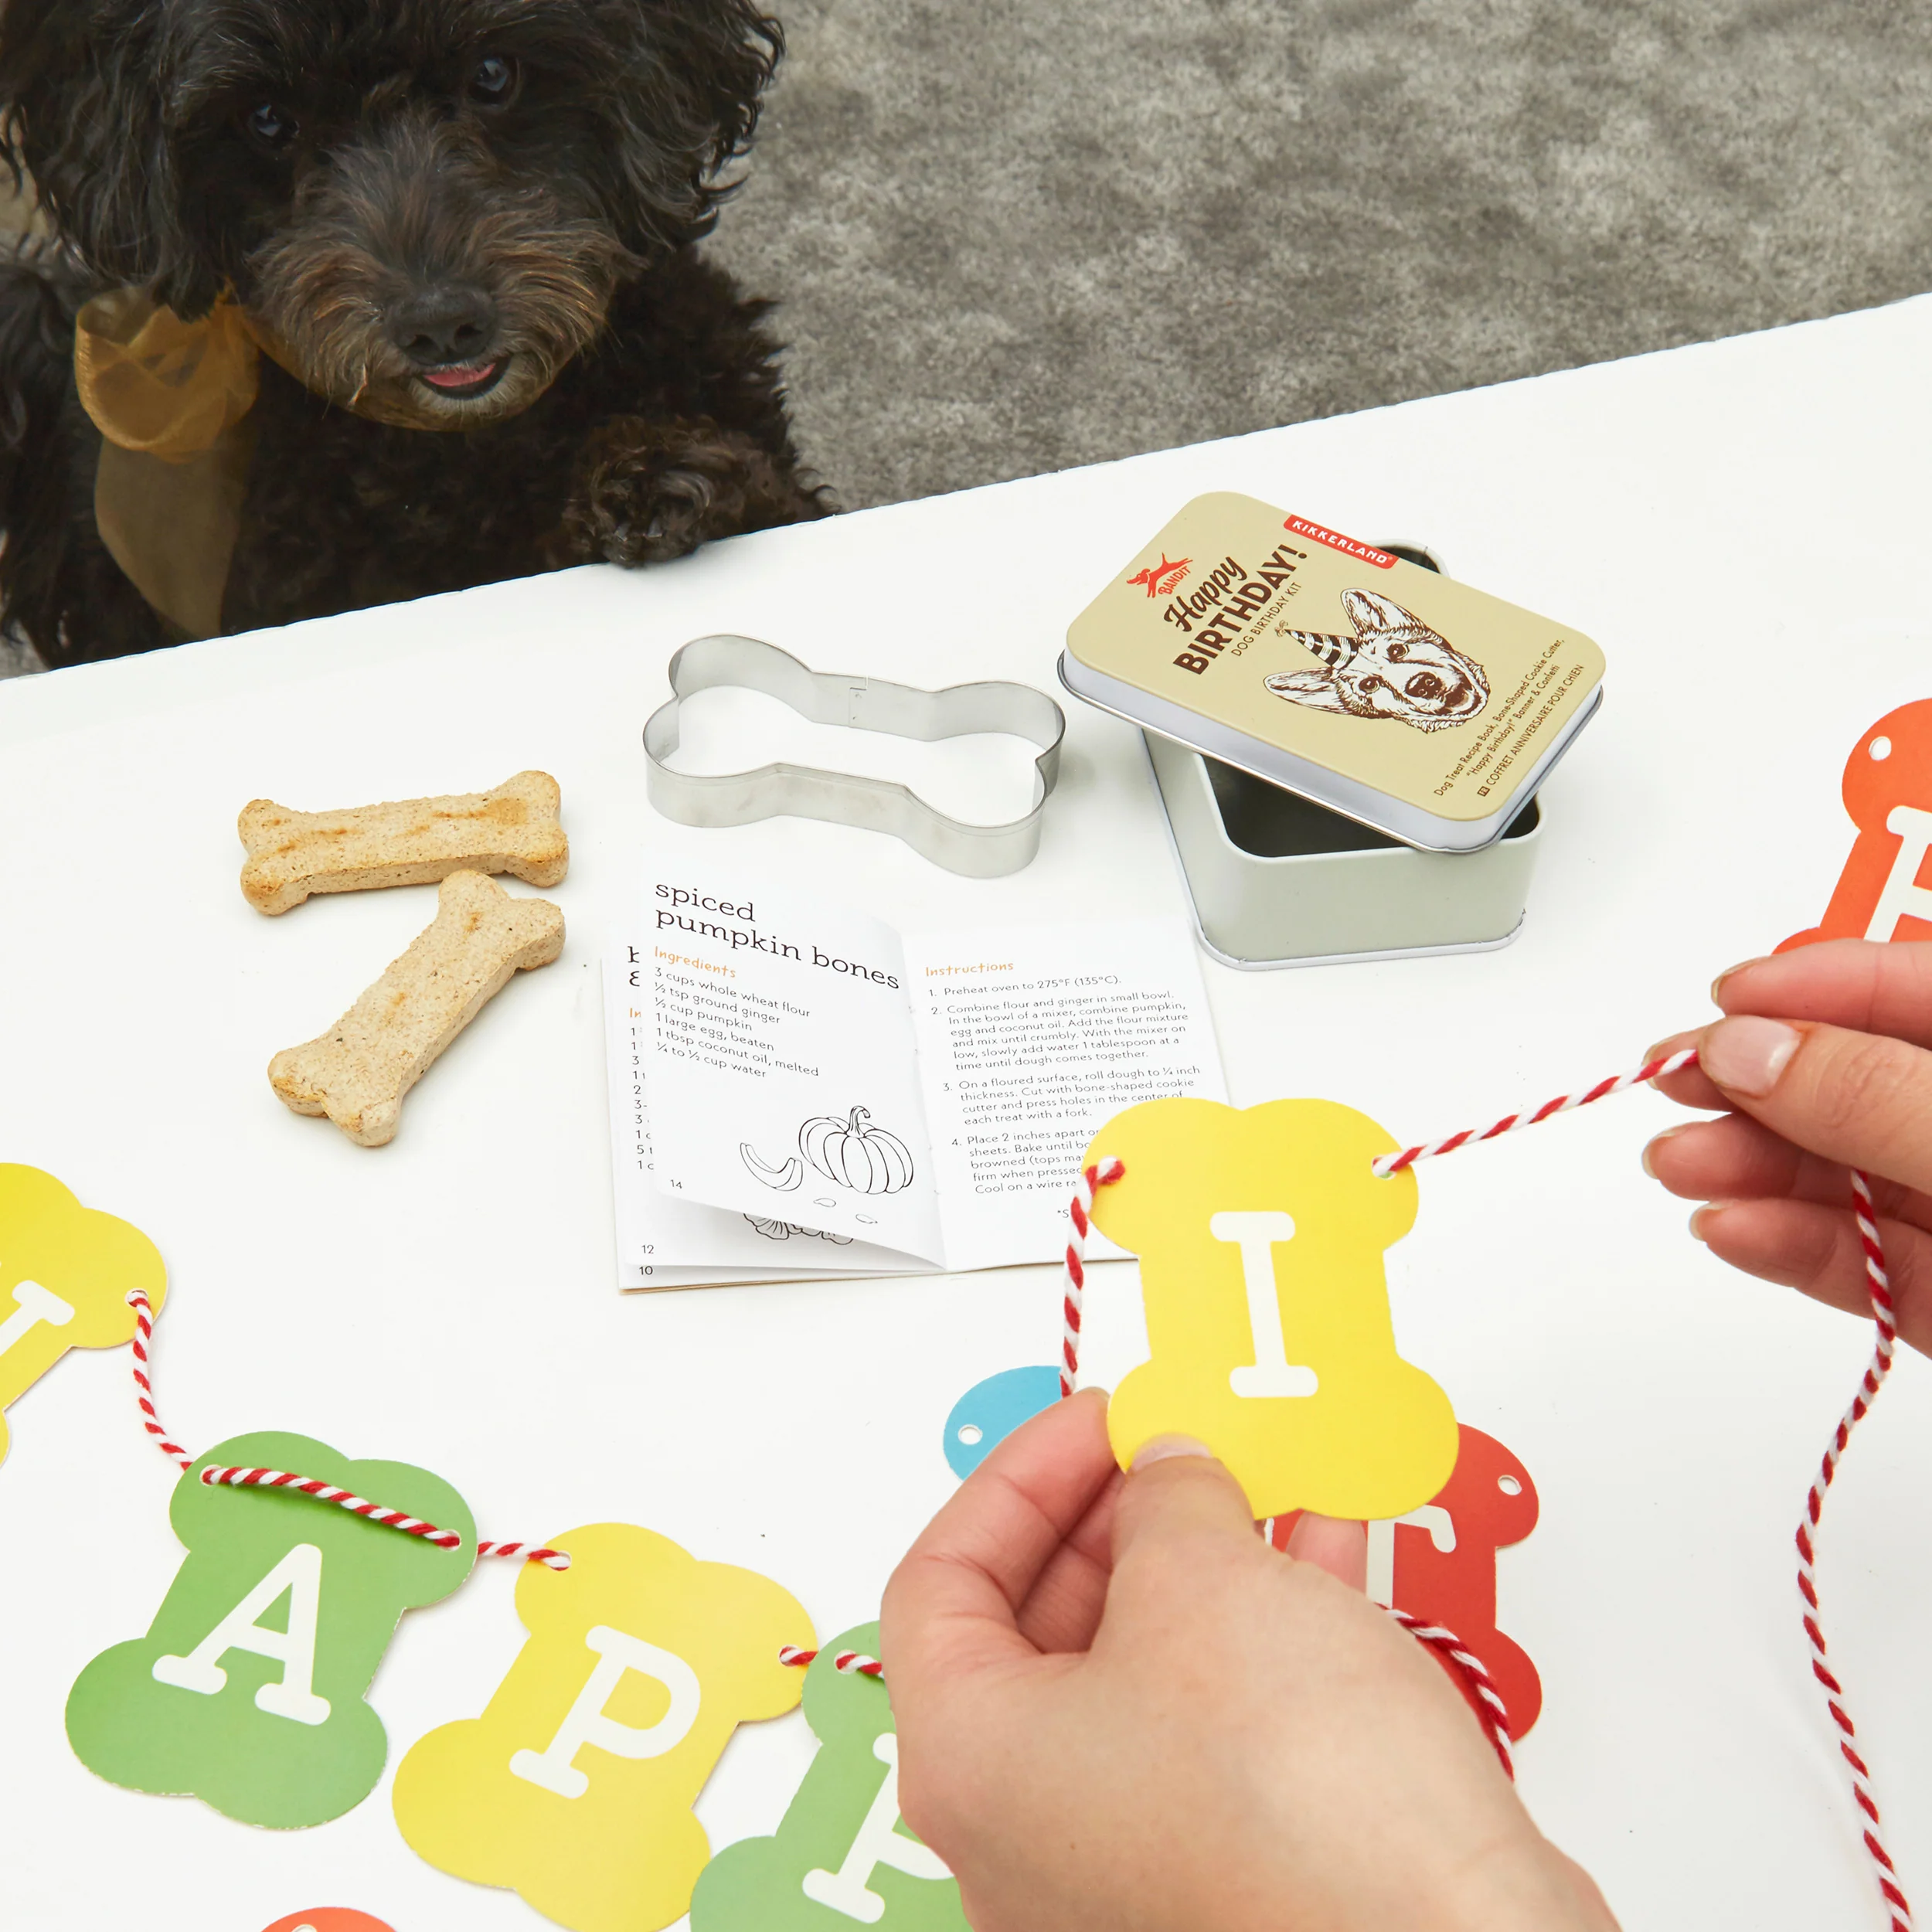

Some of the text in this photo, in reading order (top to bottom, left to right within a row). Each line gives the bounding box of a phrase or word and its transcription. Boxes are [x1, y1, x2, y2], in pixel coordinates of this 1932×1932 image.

[1292, 520, 1388, 564] KIKKERLAND
[1158, 566, 1191, 595] BANDIT
[1163, 556, 1248, 632] Happy
[1172, 544, 1308, 675] BIRTHDAY!
[1231, 582, 1302, 657] DOG BIRTHDAY KIT
[1512, 696, 1536, 719] Banner
[1536, 664, 1560, 690] Confetti
[1434, 638, 1566, 796] Dog Treat Recipe Book, Bone-Shaped Cookie Cutter,
[1485, 664, 1585, 785] COFFRET ANNIVERSAIRE POUR CHIEN
[655, 883, 757, 923] spiced
[655, 909, 900, 989] pumpkin bones
[655, 945, 736, 978] Ingredients
[925, 962, 1014, 977] Instructions
[655, 966, 811, 1017] 3 cups whole wheat flour
[929, 988, 937, 997] 1.
[944, 986, 988, 995] Preheat
[930, 1006, 942, 1015] 2.
[947, 1003, 999, 1014] Combine
[1003, 1001, 1029, 1009] flour
[1032, 998, 1054, 1008] and
[1057, 998, 1094, 1008] ginger
[1111, 992, 1139, 1002] small
[1141, 990, 1174, 1000] bowl.
[669, 988, 781, 1024] tsp ground ginger
[670, 1004, 752, 1031] cup pumpkin
[948, 1016, 960, 1025] In
[962, 1015, 981, 1024] the
[985, 1012, 1014, 1022] bowl
[1017, 1010, 1029, 1020] of
[1079, 1005, 1128, 1015] combine
[1131, 1002, 1186, 1014] pumpkin,
[655, 1012, 661, 1022] 1
[665, 1014, 696, 1032] large
[699, 1026, 727, 1041] egg,
[730, 1031, 774, 1051] beaten
[951, 1014, 1189, 1038] egg and coconut oil. Add the flour mixture
[952, 1038, 974, 1048] and
[977, 1037, 998, 1046] mix
[1001, 1033, 1027, 1044] until
[1030, 1030, 1079, 1042] crumbly.
[1081, 1028, 1111, 1037] With
[1114, 1027, 1133, 1036] the
[656, 1027, 819, 1077] 1 tbsp coconut oil, melted
[672, 1046, 767, 1078] to cup water
[954, 1050, 978, 1059] low,
[981, 1046, 1018, 1057] slowly
[1021, 1044, 1043, 1053] add
[1090, 1039, 1156, 1049] tablespoon
[955, 1049, 1148, 1071] time until dough comes together.
[943, 1083, 953, 1092] 3.
[958, 1080, 978, 1090] On
[991, 1075, 1034, 1087] floured
[1037, 1073, 1082, 1083] surface,
[1085, 1070, 1104, 1080] roll
[1107, 1068, 1145, 1080] dough
[1176, 1065, 1200, 1075] inch
[961, 1078, 1195, 1101] thickness. Cut with bone-shaped cookie
[962, 1104, 998, 1114] cutter
[1001, 1100, 1022, 1110] and
[1026, 1100, 1057, 1110] press
[1060, 1096, 1091, 1105] holes
[1108, 1094, 1128, 1103] the
[1131, 1094, 1168, 1102] center
[964, 1114, 992, 1125] each
[995, 1114, 1023, 1122] treat
[1026, 1110, 1053, 1119] with
[1065, 1107, 1092, 1117] fork.
[967, 1134, 998, 1145] Place
[1002, 1132, 1009, 1141] 2
[1013, 1131, 1051, 1141] inches
[1054, 1129, 1085, 1140] apart
[969, 1147, 1012, 1158] sheets.
[1014, 1143, 1043, 1153] Bake
[1046, 1140, 1073, 1151] until
[971, 1155, 1061, 1169] browned (tops
[973, 1169, 1034, 1182] firm when
[670, 1179, 682, 1189] 14
[975, 1182, 1004, 1194] Cool
[1036, 1179, 1063, 1189] wire
[641, 1244, 655, 1254] 12
[638, 1266, 653, 1276] 10
[1209, 1211, 1318, 1398] I
[152, 1543, 331, 1726] A
[509, 1624, 701, 1798] P
